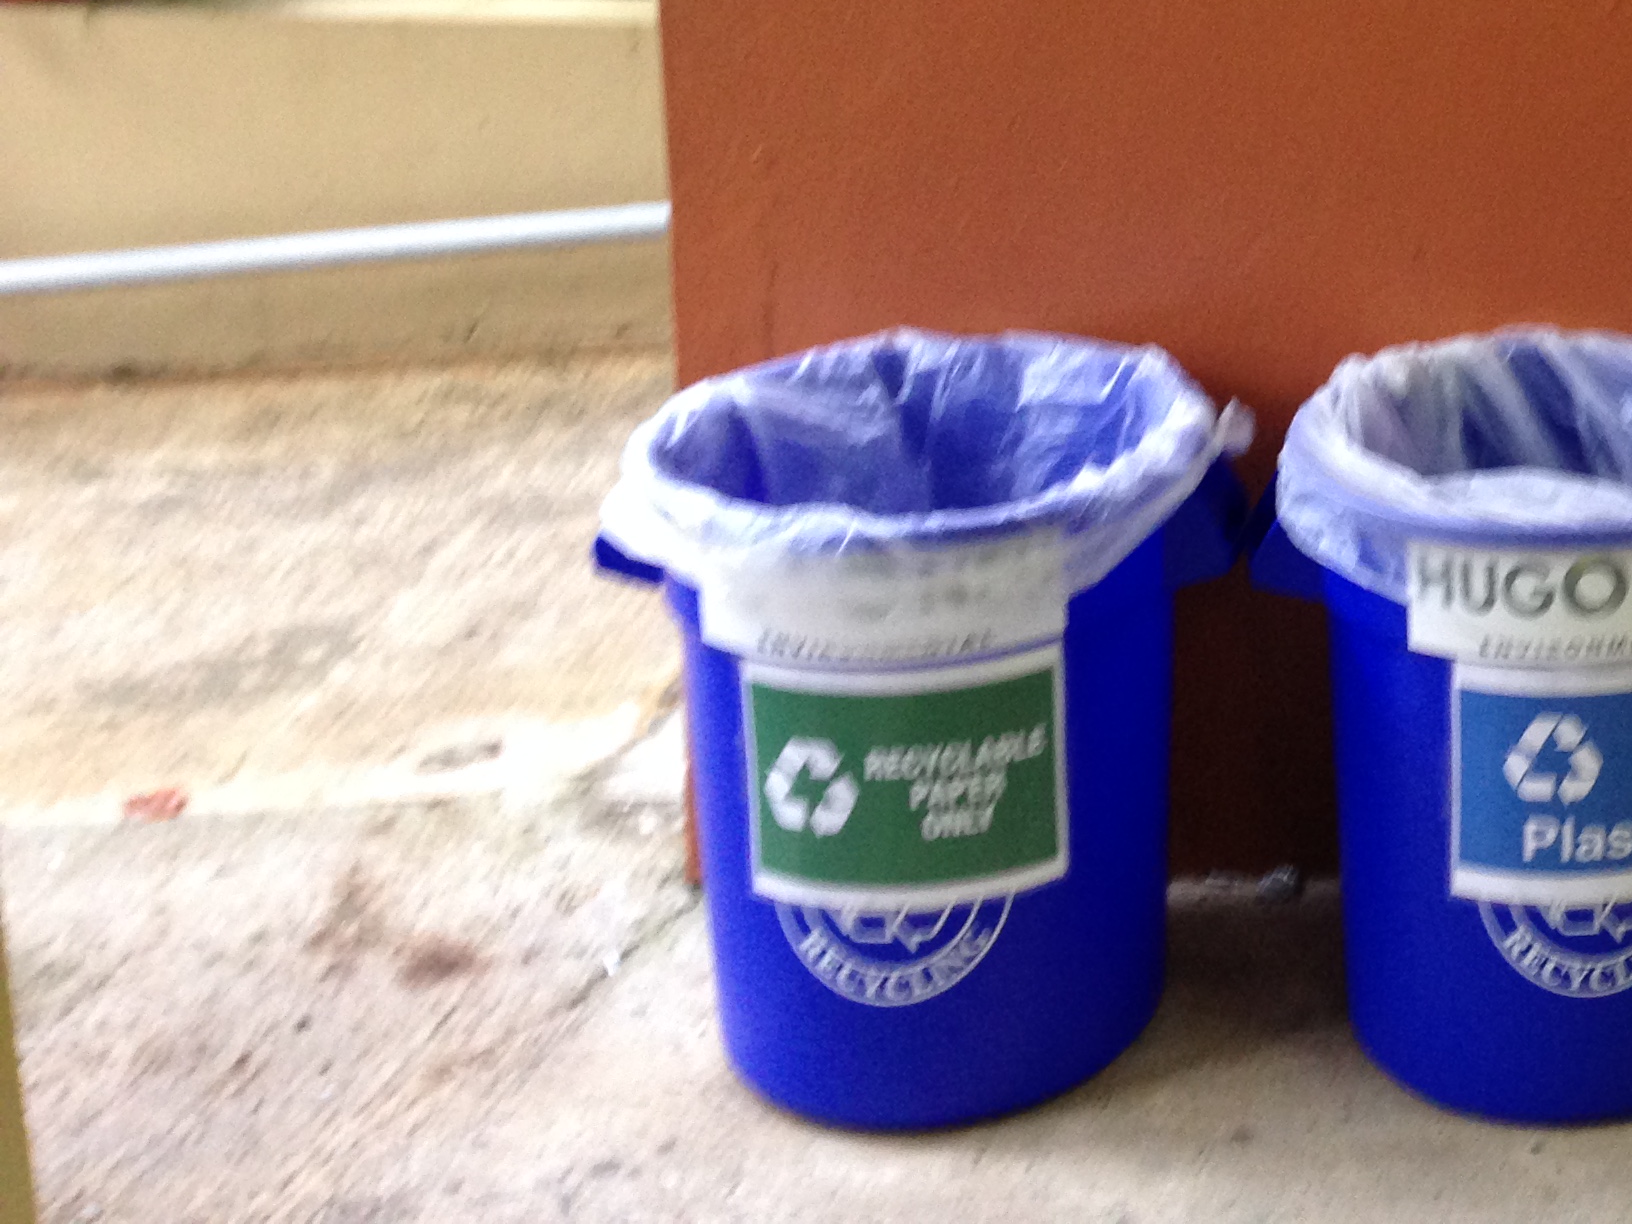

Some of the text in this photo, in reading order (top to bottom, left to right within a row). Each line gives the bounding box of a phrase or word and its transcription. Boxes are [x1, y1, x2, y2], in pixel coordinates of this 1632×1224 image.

[1416, 547, 1632, 620] HUGO
[863, 723, 1048, 782] RECYCLABLE
[909, 766, 1007, 811] PAPER
[920, 803, 994, 842] ONLY
[800, 924, 993, 1004] RECYCLING
